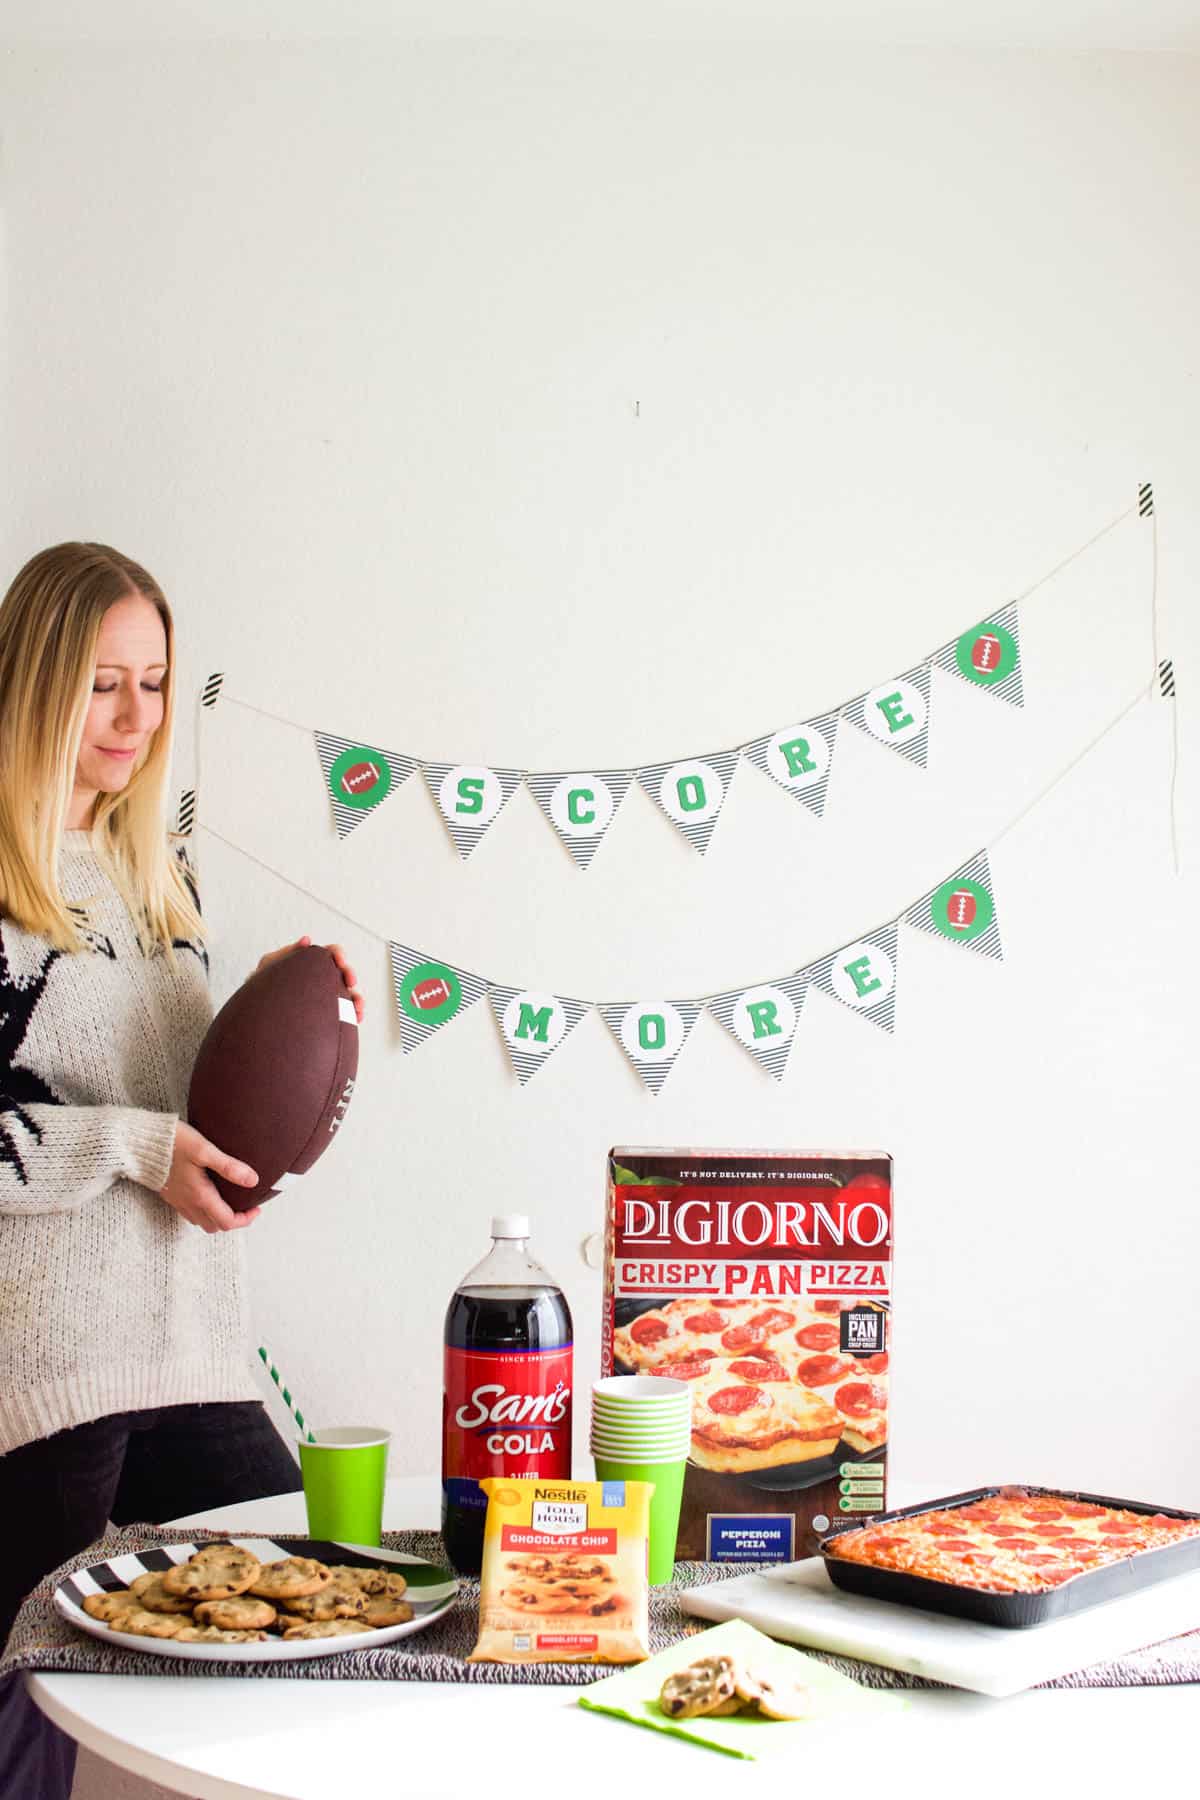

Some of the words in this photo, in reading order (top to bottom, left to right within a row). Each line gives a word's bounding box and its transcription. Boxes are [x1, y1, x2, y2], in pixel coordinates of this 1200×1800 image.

[455, 691, 913, 825] SCORE
[515, 956, 880, 1050] MORE
[622, 1200, 890, 1246] DIGIORNO
[622, 1263, 717, 1284] CRISPY
[725, 1264, 802, 1295] PAN
[811, 1265, 886, 1286] PIZZA
[848, 1320, 877, 1338] PAN
[456, 1382, 570, 1429] Sam's
[486, 1433, 555, 1455] COLA
[537, 1514, 583, 1524] HOUSE
[544, 1505, 578, 1514] TOLL
[510, 1534, 578, 1545] CHOCOLATE
[581, 1536, 609, 1546] CHIP
[721, 1530, 781, 1539] PEPPERONI
[735, 1540, 766, 1548] PIZZA
